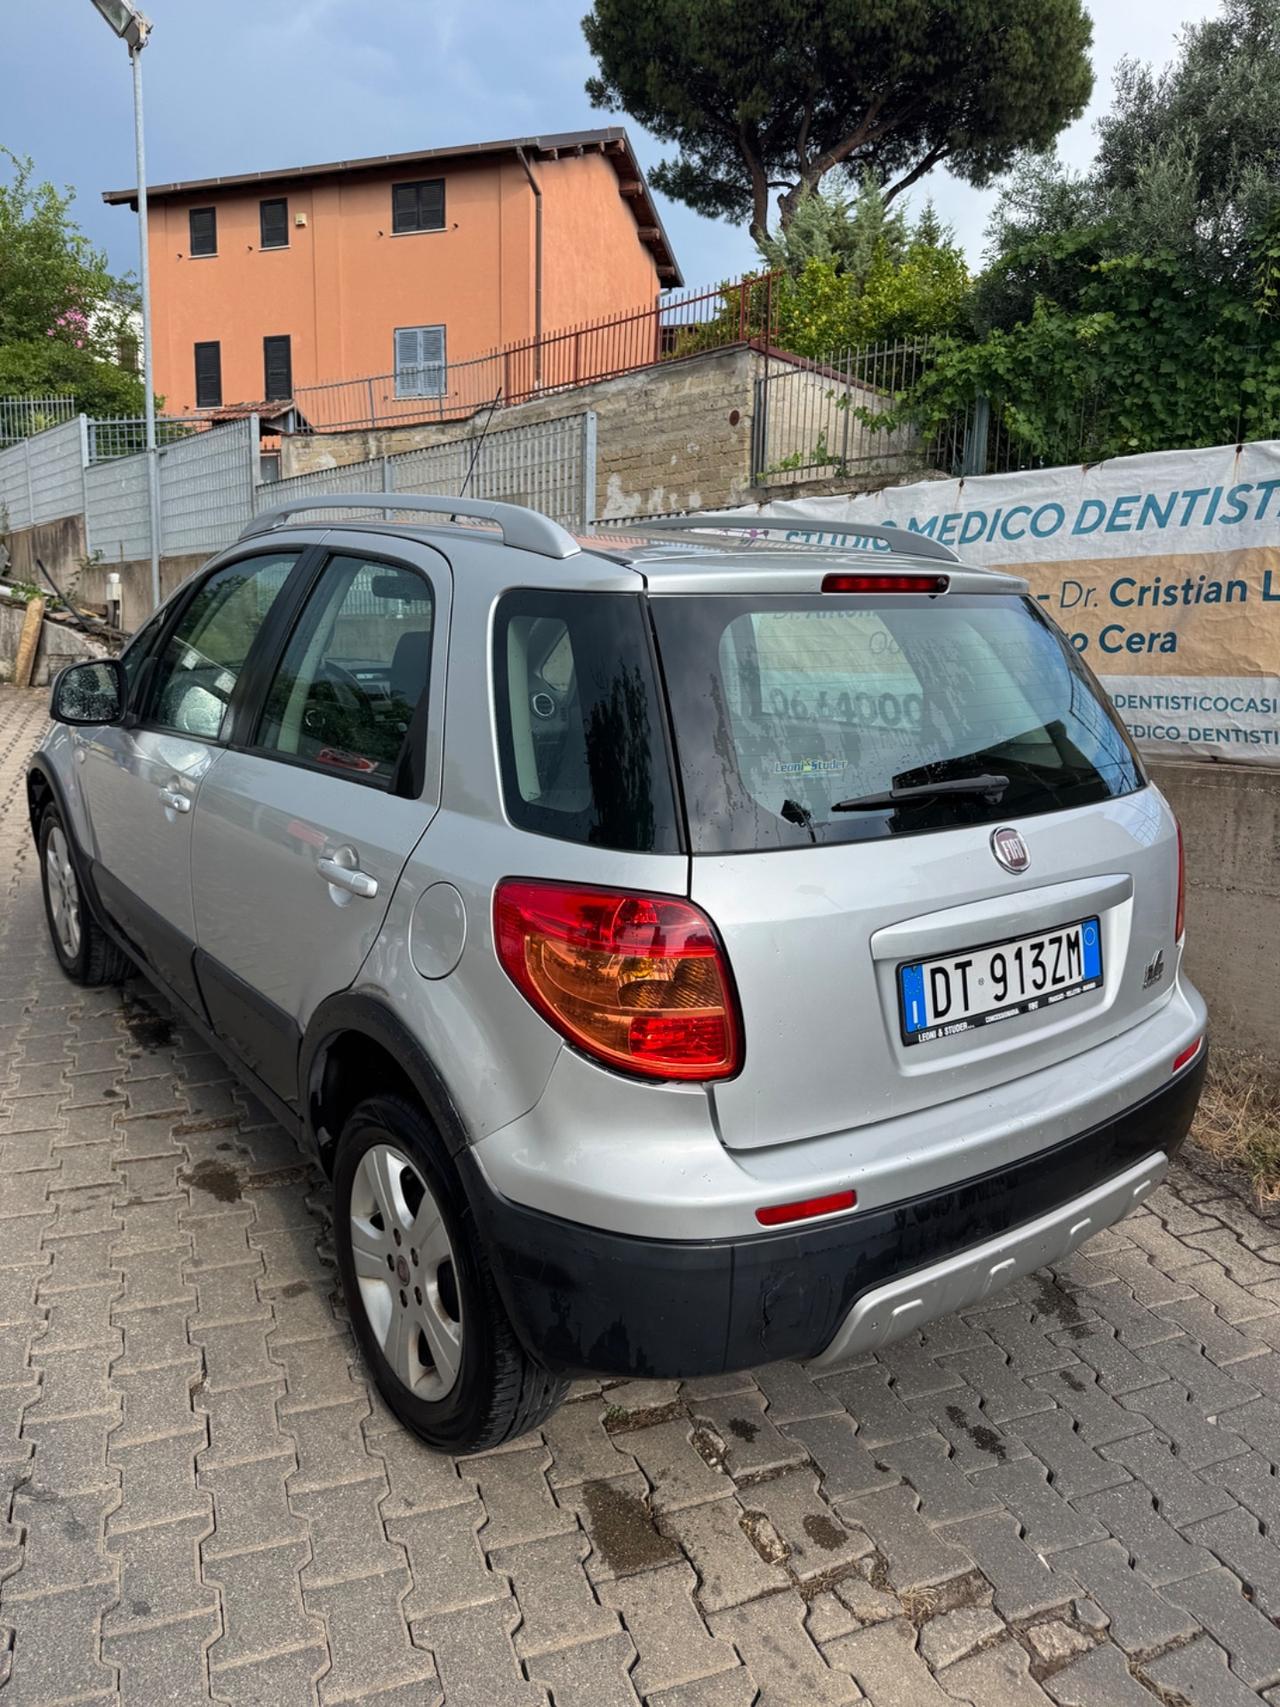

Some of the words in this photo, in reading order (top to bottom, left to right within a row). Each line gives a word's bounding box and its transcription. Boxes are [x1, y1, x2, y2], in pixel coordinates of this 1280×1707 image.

[1071, 479, 1280, 536] DENTIST
[1060, 581, 1098, 608] Dr.
[1110, 575, 1247, 608] Cristian
[1065, 632, 1088, 653] o
[1099, 624, 1178, 654] Cera
[1110, 694, 1277, 713] DENTISTICOCASI
[1000, 839, 1025, 861] FIAT
[930, 960, 973, 1019] DT
[990, 930, 1082, 1002] 913ZM
